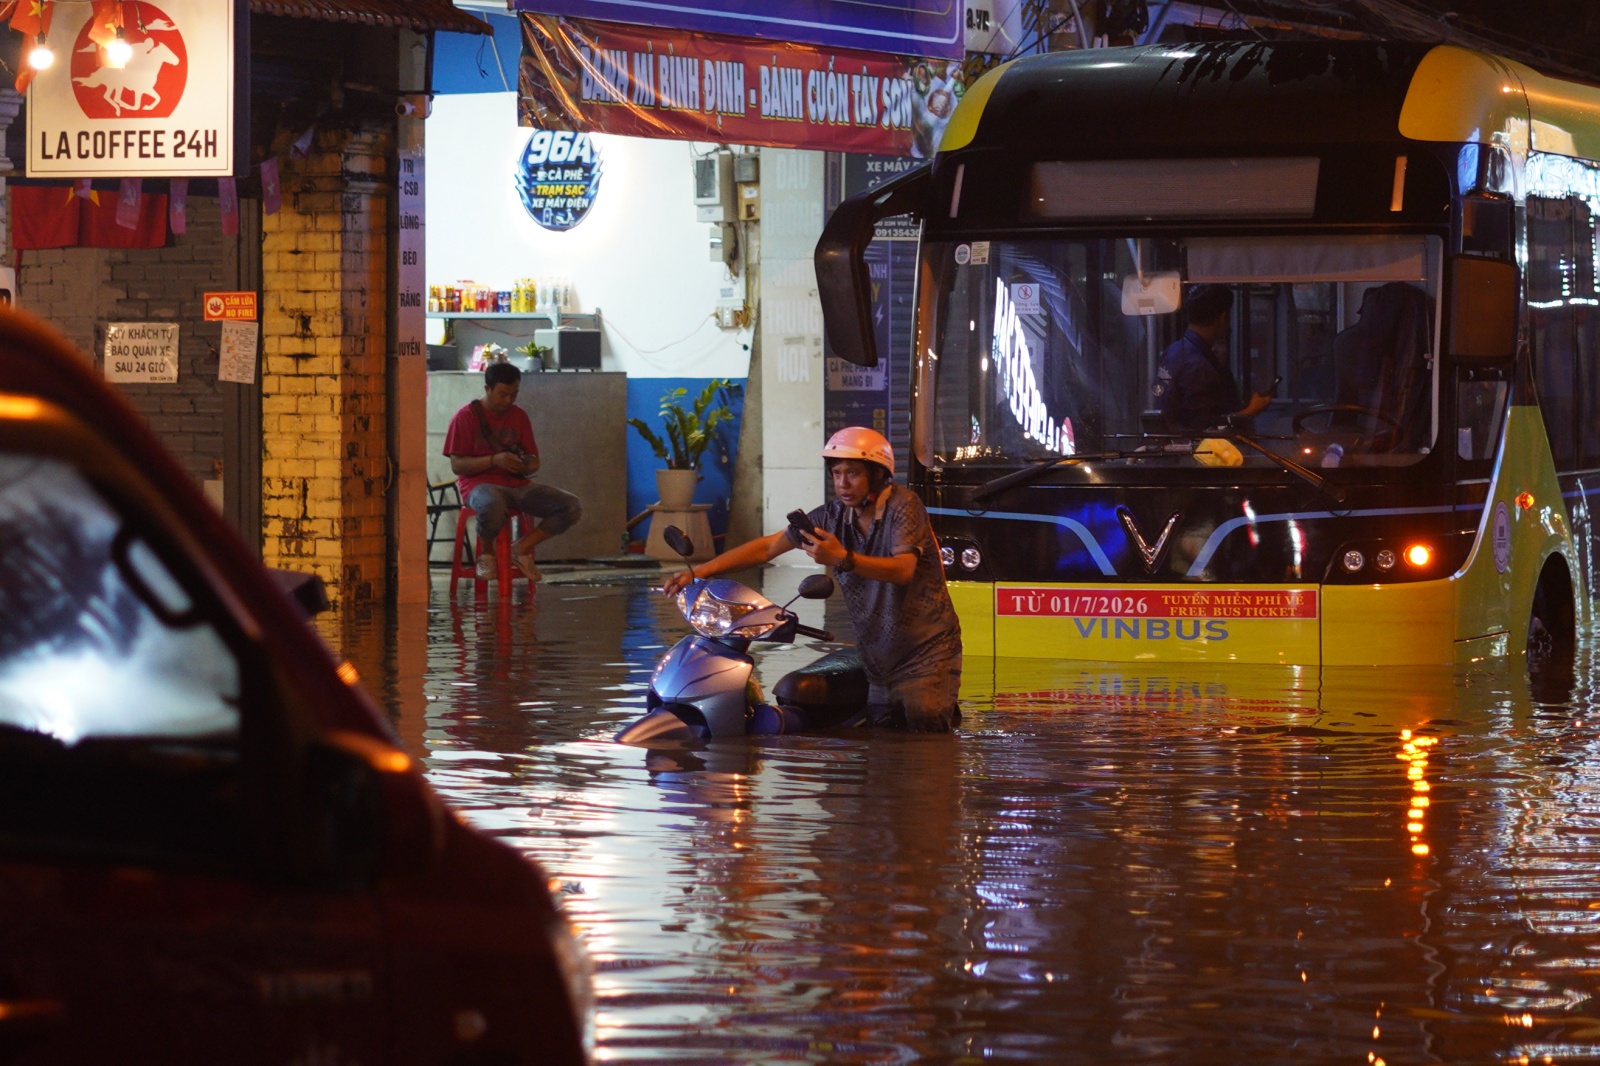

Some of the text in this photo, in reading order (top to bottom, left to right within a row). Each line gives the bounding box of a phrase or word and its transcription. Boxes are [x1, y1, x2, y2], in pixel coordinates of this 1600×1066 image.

[580, 36, 629, 104] BÁNH
[658, 43, 700, 110] BÌNH
[703, 59, 745, 127] ĐỊNH
[760, 55, 803, 120] BÁNH
[807, 55, 849, 123] CUỐN
[852, 65, 878, 126] TÂY
[41, 129, 218, 160] LA COFFEE 24H
[528, 131, 591, 165] 96A
[866, 161, 881, 172] XE
[884, 157, 910, 172] MÁY
[548, 167, 583, 180] CÀ PHÊ
[536, 185, 585, 198] TRẠM SẠC
[533, 197, 589, 210] XE MÁY ĐIỆN
[225, 295, 239, 305] CẤM
[226, 309, 253, 317] NO FIRE
[128, 325, 159, 340] KHÁCH
[111, 341, 171, 359] BẢO QUẢN XE
[115, 358, 166, 373] SAU 24 GIỜ
[1011, 591, 1148, 614] TỪ 01/7/2026
[1161, 592, 1304, 606] TUYẾN MIỄN PHÍ VÉ
[1169, 606, 1298, 617] FREE BUS TICKET
[1072, 617, 1230, 641] VINBUS
